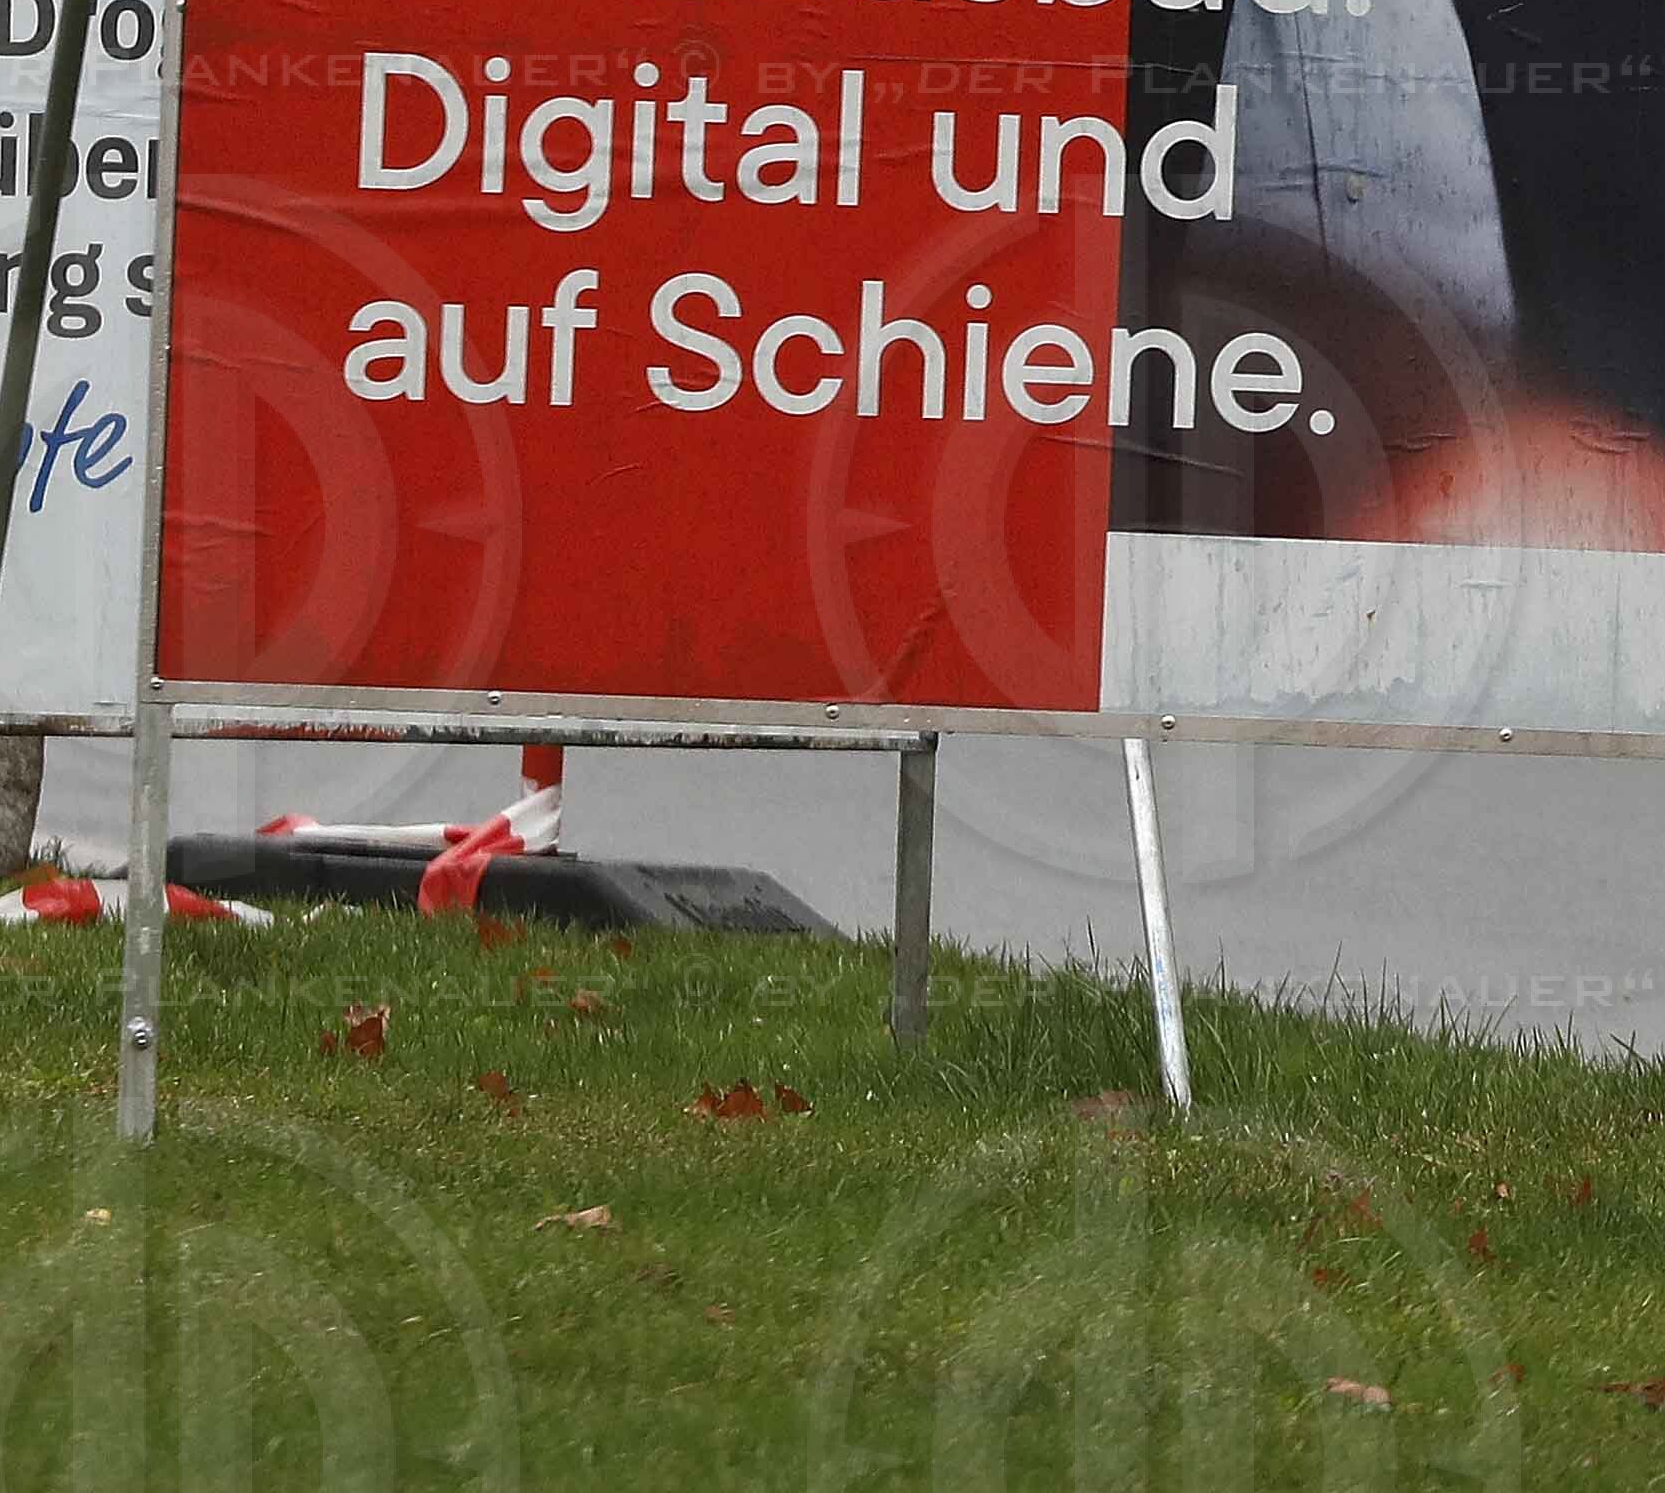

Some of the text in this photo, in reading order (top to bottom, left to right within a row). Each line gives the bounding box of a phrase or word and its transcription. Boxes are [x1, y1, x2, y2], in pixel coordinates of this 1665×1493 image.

[357, 52, 1239, 233] Digital und
[344, 267, 1339, 438] auf Schiene.
